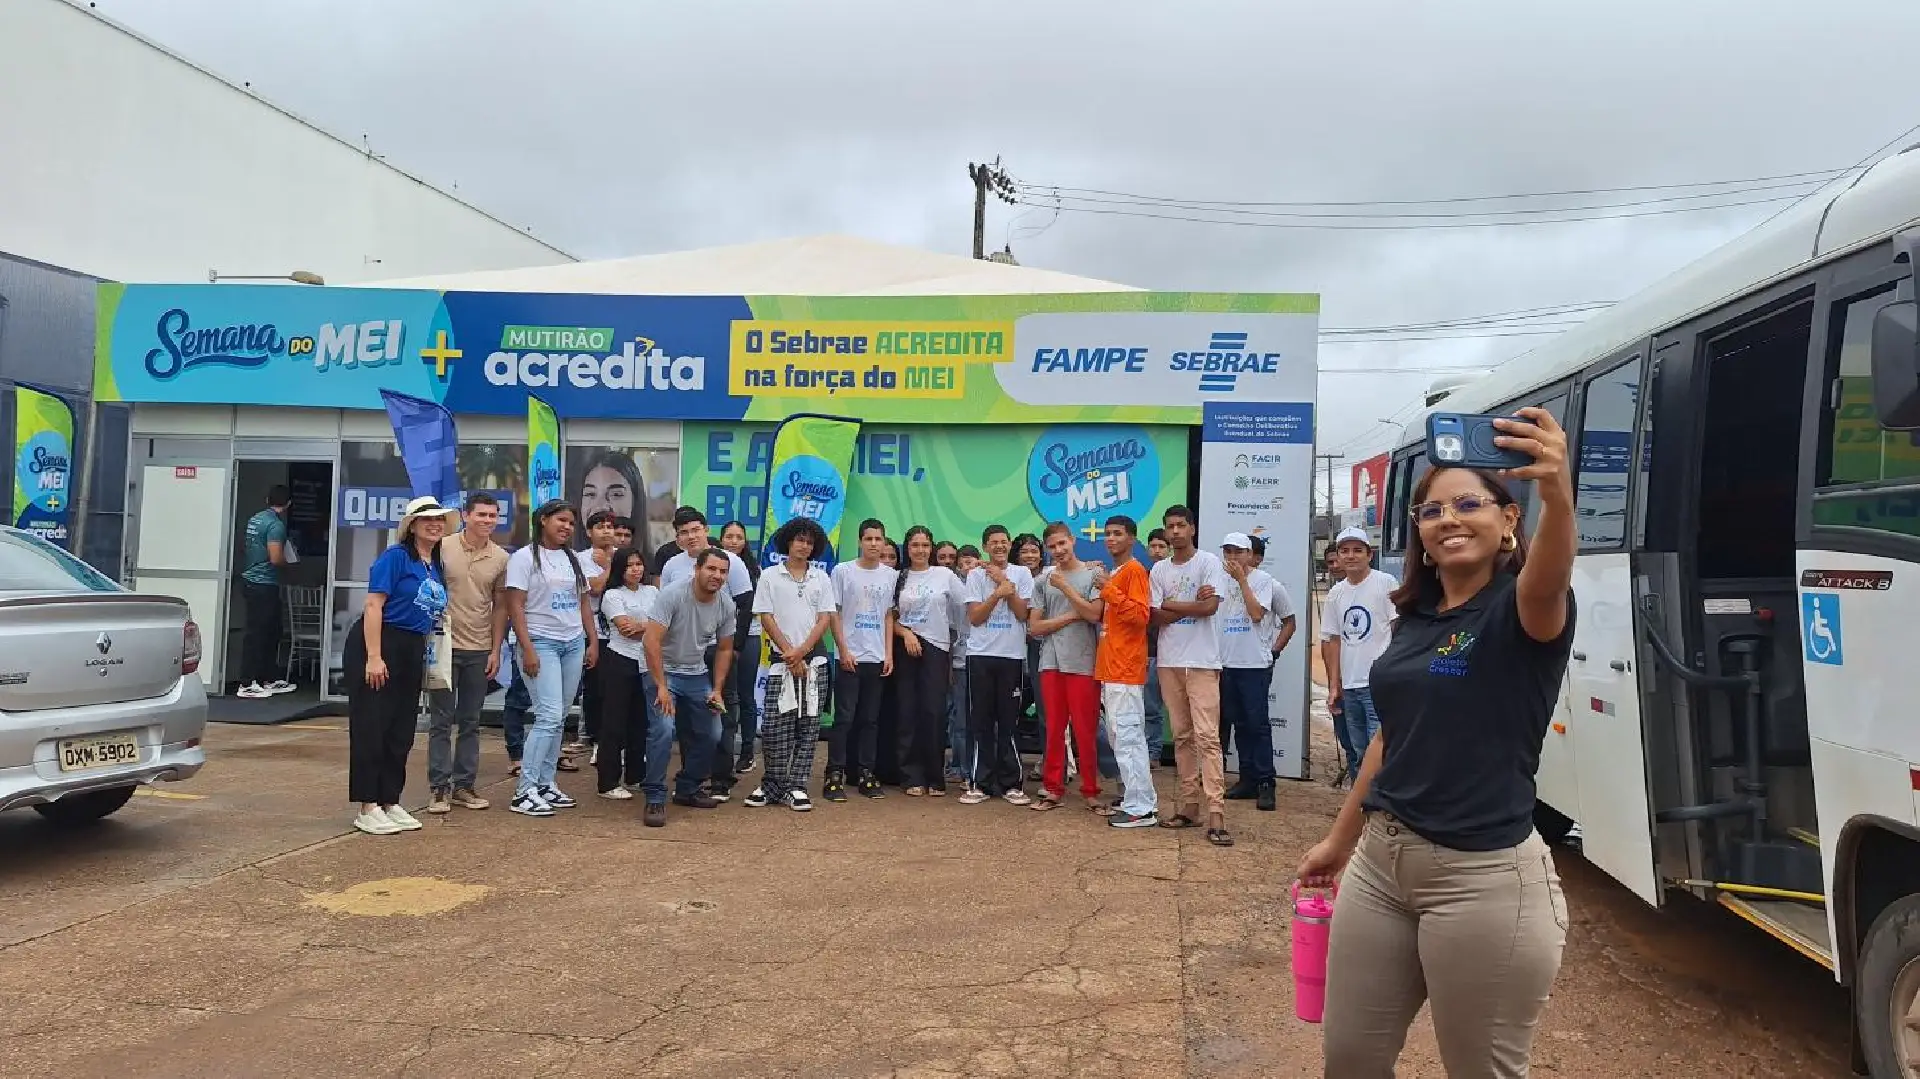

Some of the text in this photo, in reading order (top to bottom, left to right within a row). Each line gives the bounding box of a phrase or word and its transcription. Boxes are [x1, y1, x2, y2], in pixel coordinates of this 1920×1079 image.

[145, 308, 284, 379] Semana
[288, 336, 315, 356] DO
[315, 320, 405, 370] MEI
[508, 327, 604, 350] MUTIRÃO
[745, 330, 1004, 355] O Sebrae ACREDITA
[484, 337, 705, 391] acredita
[1031, 347, 1149, 374] FAMPE
[1169, 351, 1281, 374] SEBRAE
[744, 364, 955, 395] na força do MEI
[1040, 438, 1146, 493] Semana
[1086, 469, 1101, 481] DO
[38, 471, 64, 490] MEI
[781, 470, 839, 500] Semana
[1066, 471, 1133, 519] MEI
[790, 498, 824, 519] MEI
[1817, 577, 1874, 588] ATTACK
[85, 658, 124, 668] LOGAN
